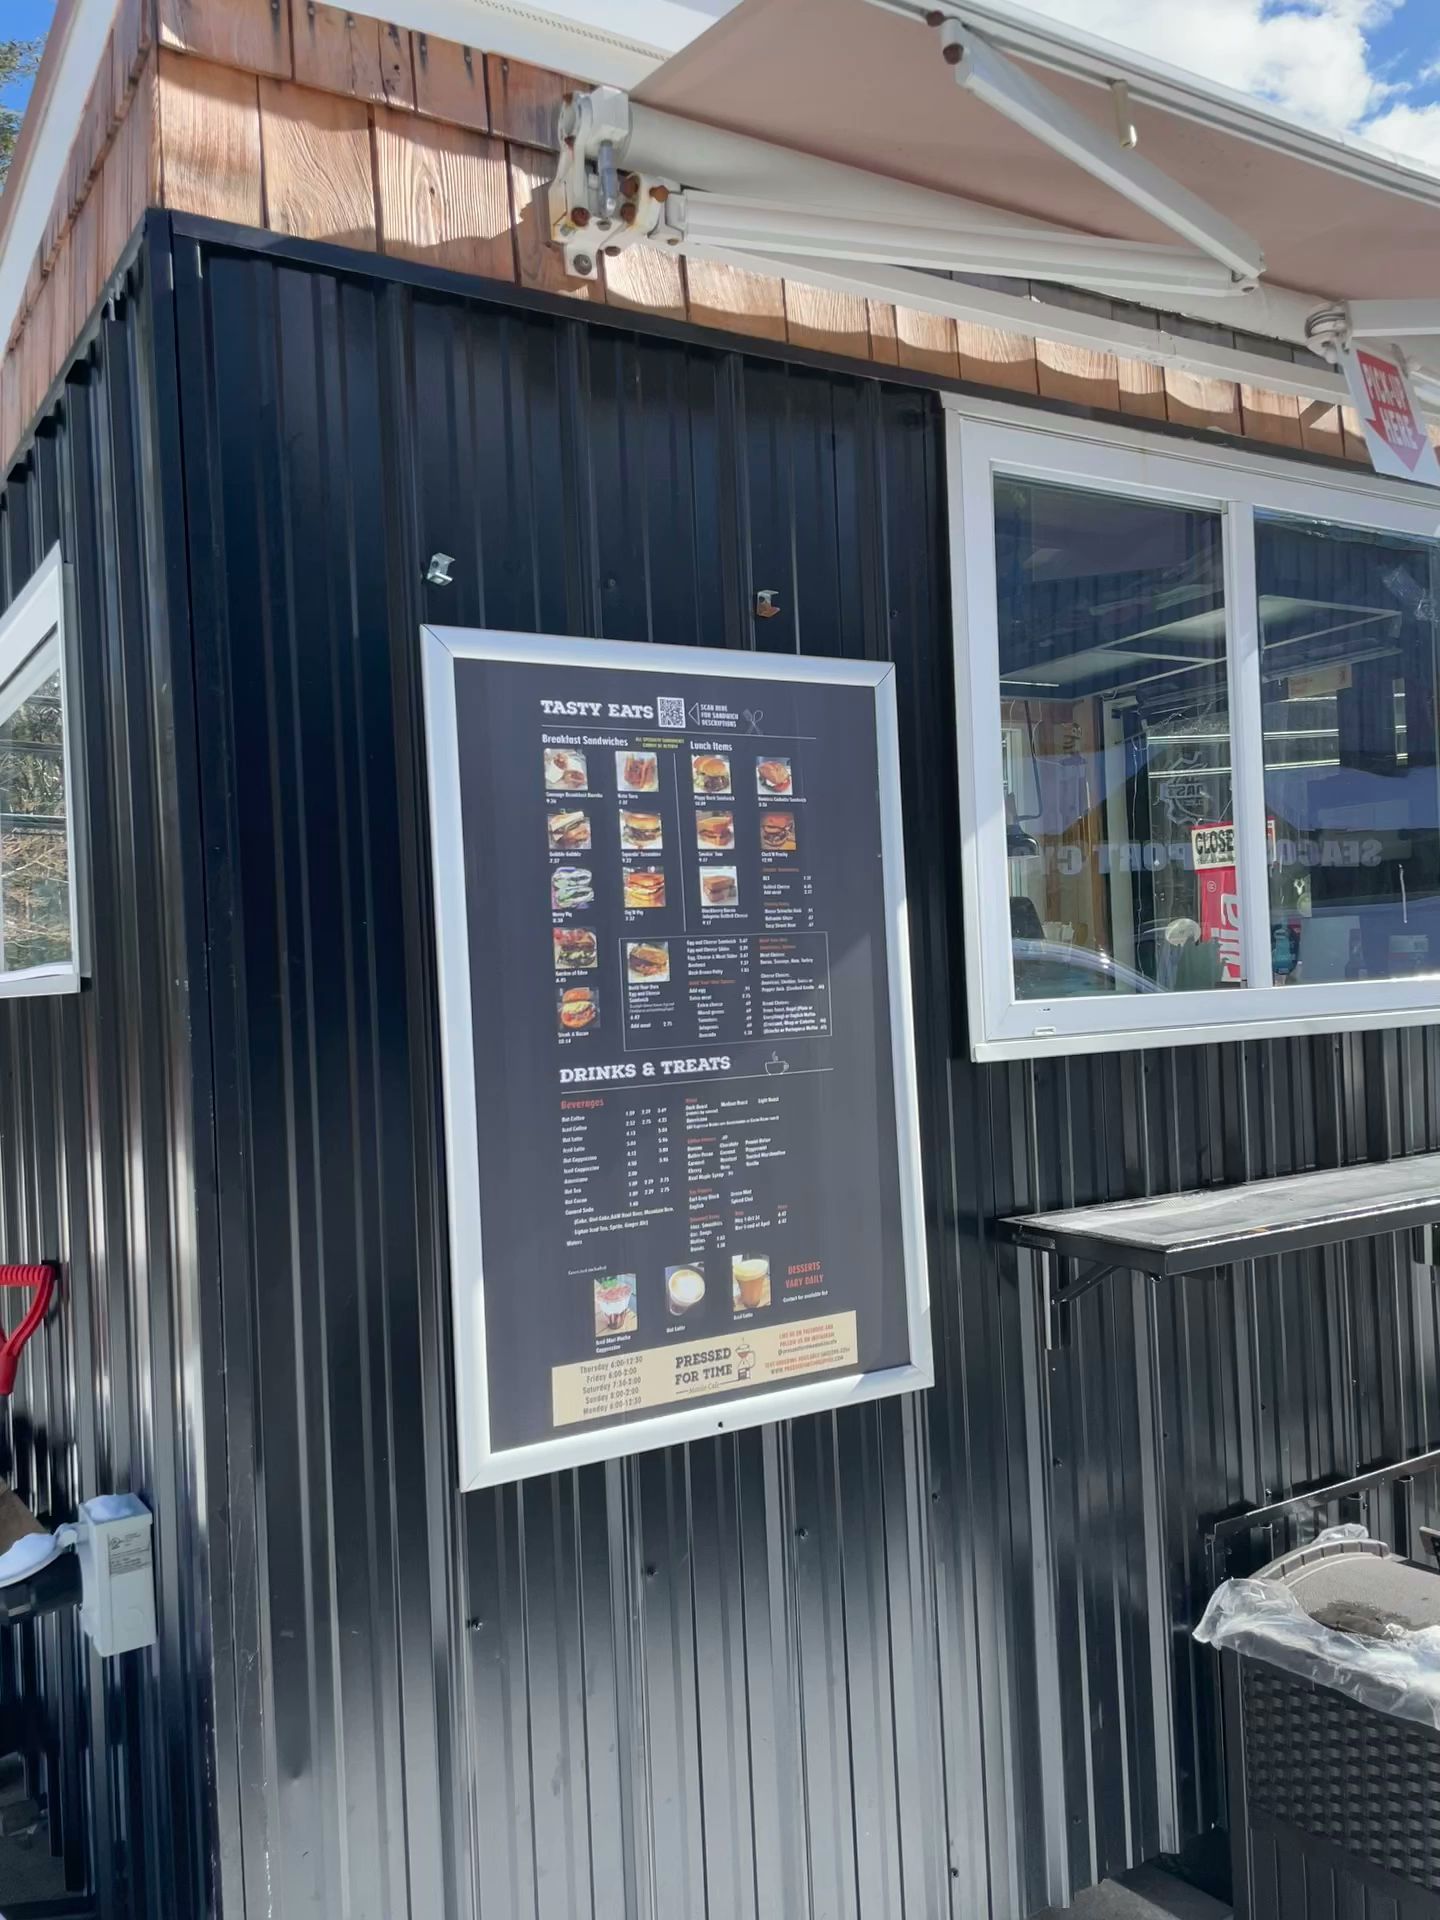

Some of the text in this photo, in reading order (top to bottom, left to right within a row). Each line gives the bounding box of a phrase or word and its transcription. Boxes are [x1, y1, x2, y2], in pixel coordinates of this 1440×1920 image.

[1378, 407, 1419, 450] HERE
[539, 699, 654, 719] TASTY EATS
[700, 703, 714, 711] SCAN
[701, 718, 736, 727] DESCRIPTIONS
[711, 711, 738, 720] SANDWICH
[541, 733, 628, 746] Breakfast Sandwiches
[689, 740, 732, 751] Lunch Items
[1195, 829, 1234, 855] CLOSE
[559, 1055, 731, 1084] DRINKS & TREATS
[560, 1096, 605, 1111] Beverages
[787, 1260, 820, 1275] DESSERTS
[785, 1273, 824, 1289] VARY DAILY
[674, 1346, 732, 1369] PRESSED
[579, 1360, 609, 1375] Thursday
[674, 1362, 733, 1386] FOR TIME
[585, 1371, 607, 1385] Friday
[581, 1381, 611, 1396] Saturday
[584, 1392, 608, 1406] Sunday
[582, 1402, 608, 1416] Monday
